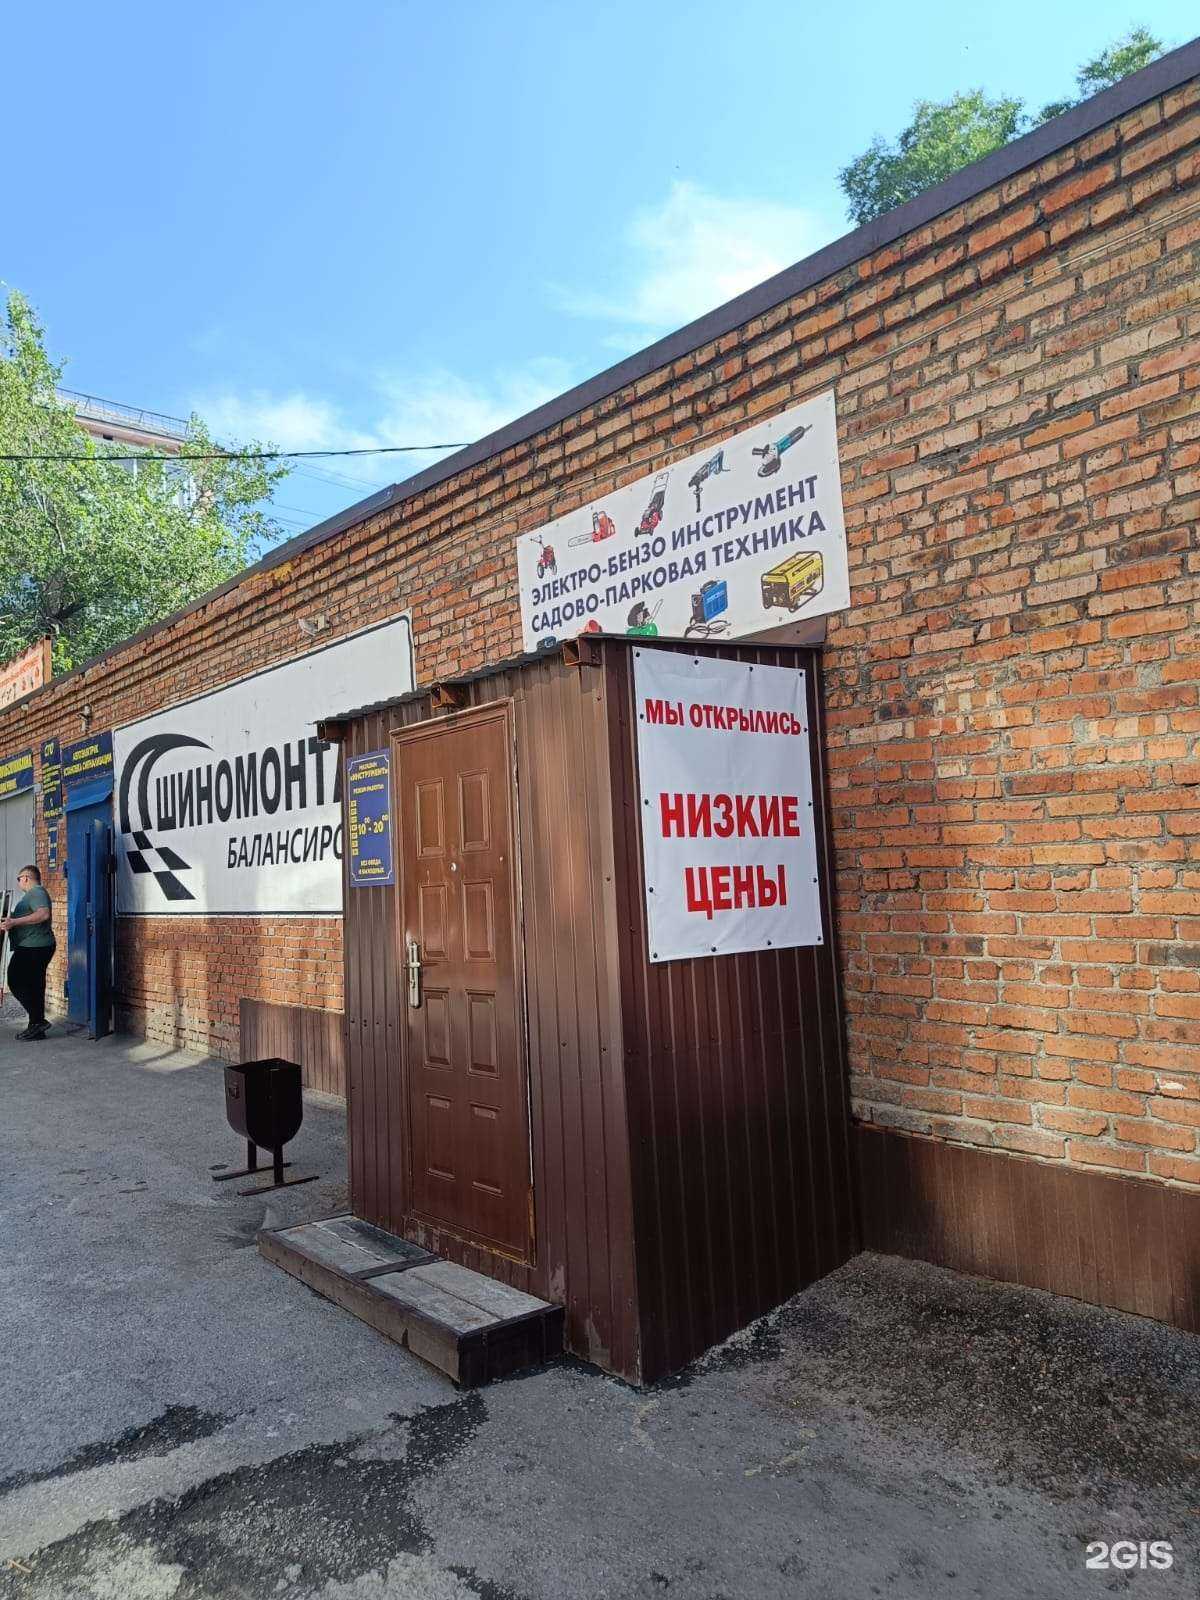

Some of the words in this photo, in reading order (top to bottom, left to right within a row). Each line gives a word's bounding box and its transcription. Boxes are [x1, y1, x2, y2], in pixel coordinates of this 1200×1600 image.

[531, 536, 666, 607] ЭЛЕКТРО-БЕНЗО
[671, 475, 818, 551] ИНСТРУМЕНТ
[531, 550, 707, 633] САДОВО-ПАРКОВАЯ
[713, 509, 826, 567] ТЕХНИКА
[645, 699, 684, 726] МЫ
[689, 703, 802, 736] ОТКРЫЛИСЬ
[660, 793, 801, 838] НИЗКИЕ
[685, 864, 787, 920] ЦЕНЫ
